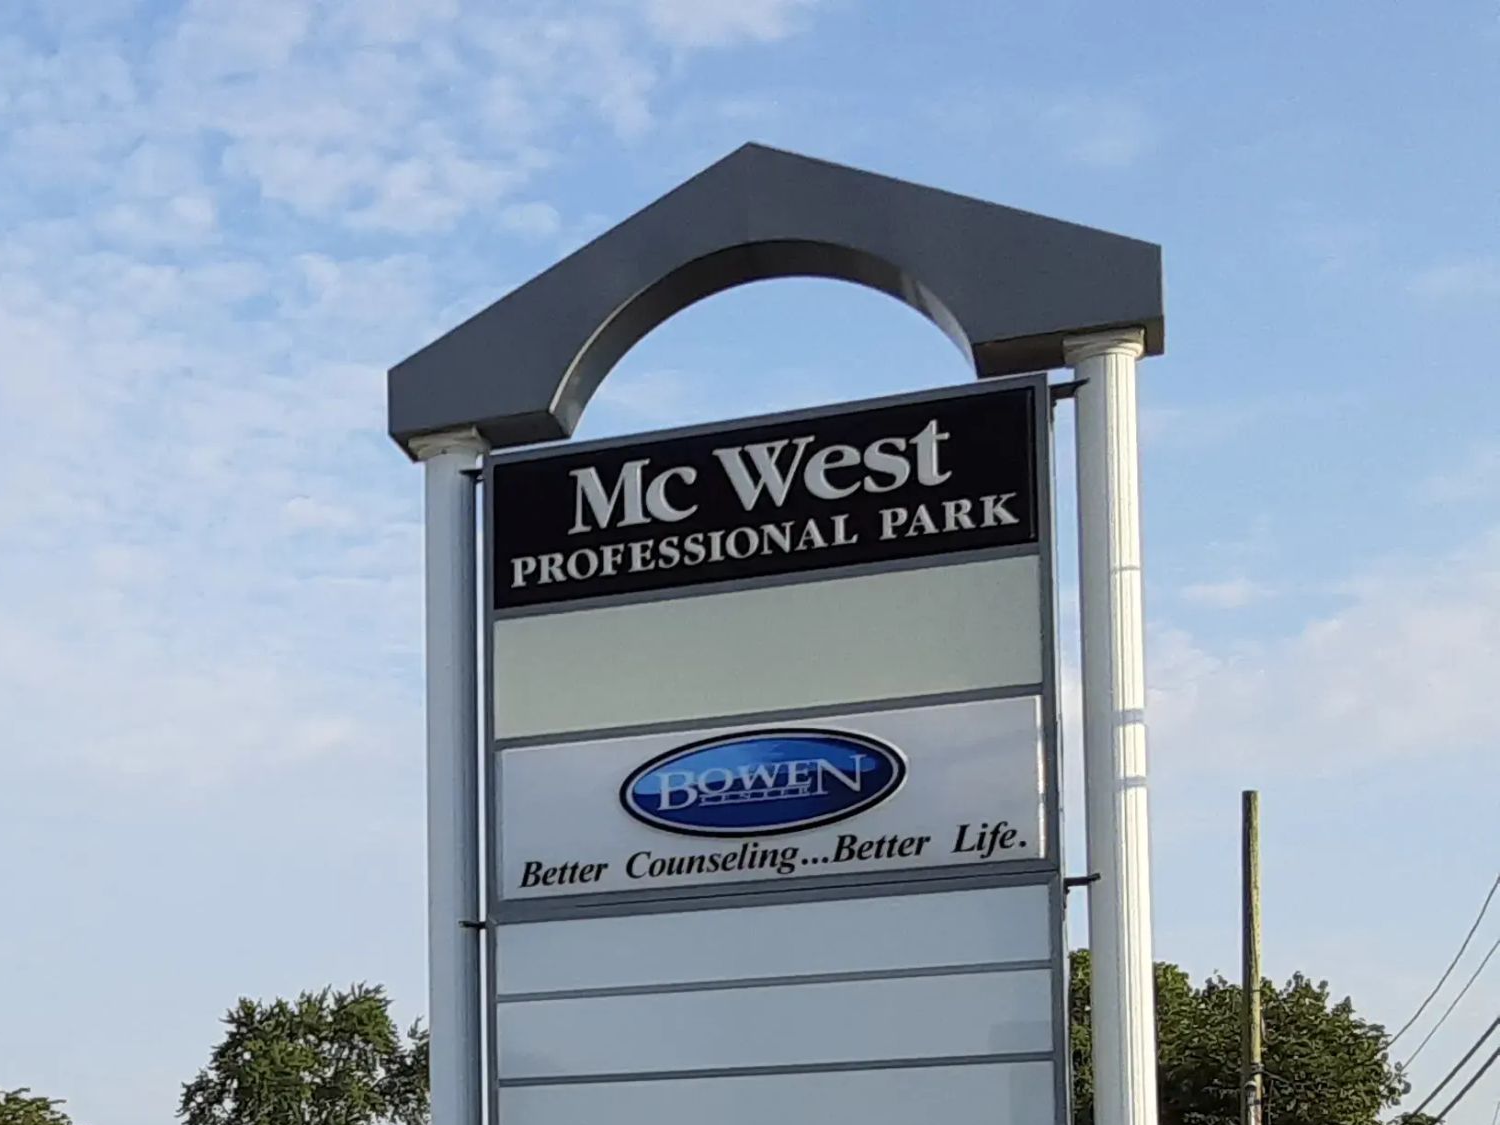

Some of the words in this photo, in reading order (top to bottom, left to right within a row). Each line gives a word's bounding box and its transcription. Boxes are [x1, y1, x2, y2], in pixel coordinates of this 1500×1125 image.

[567, 457, 699, 536] Mc
[712, 419, 953, 512] West
[510, 514, 858, 589] PROFESSIONAL
[879, 491, 1020, 541] PARK
[656, 753, 868, 811] BOWEN
[520, 857, 608, 889] Better
[951, 820, 1028, 861] Life.
